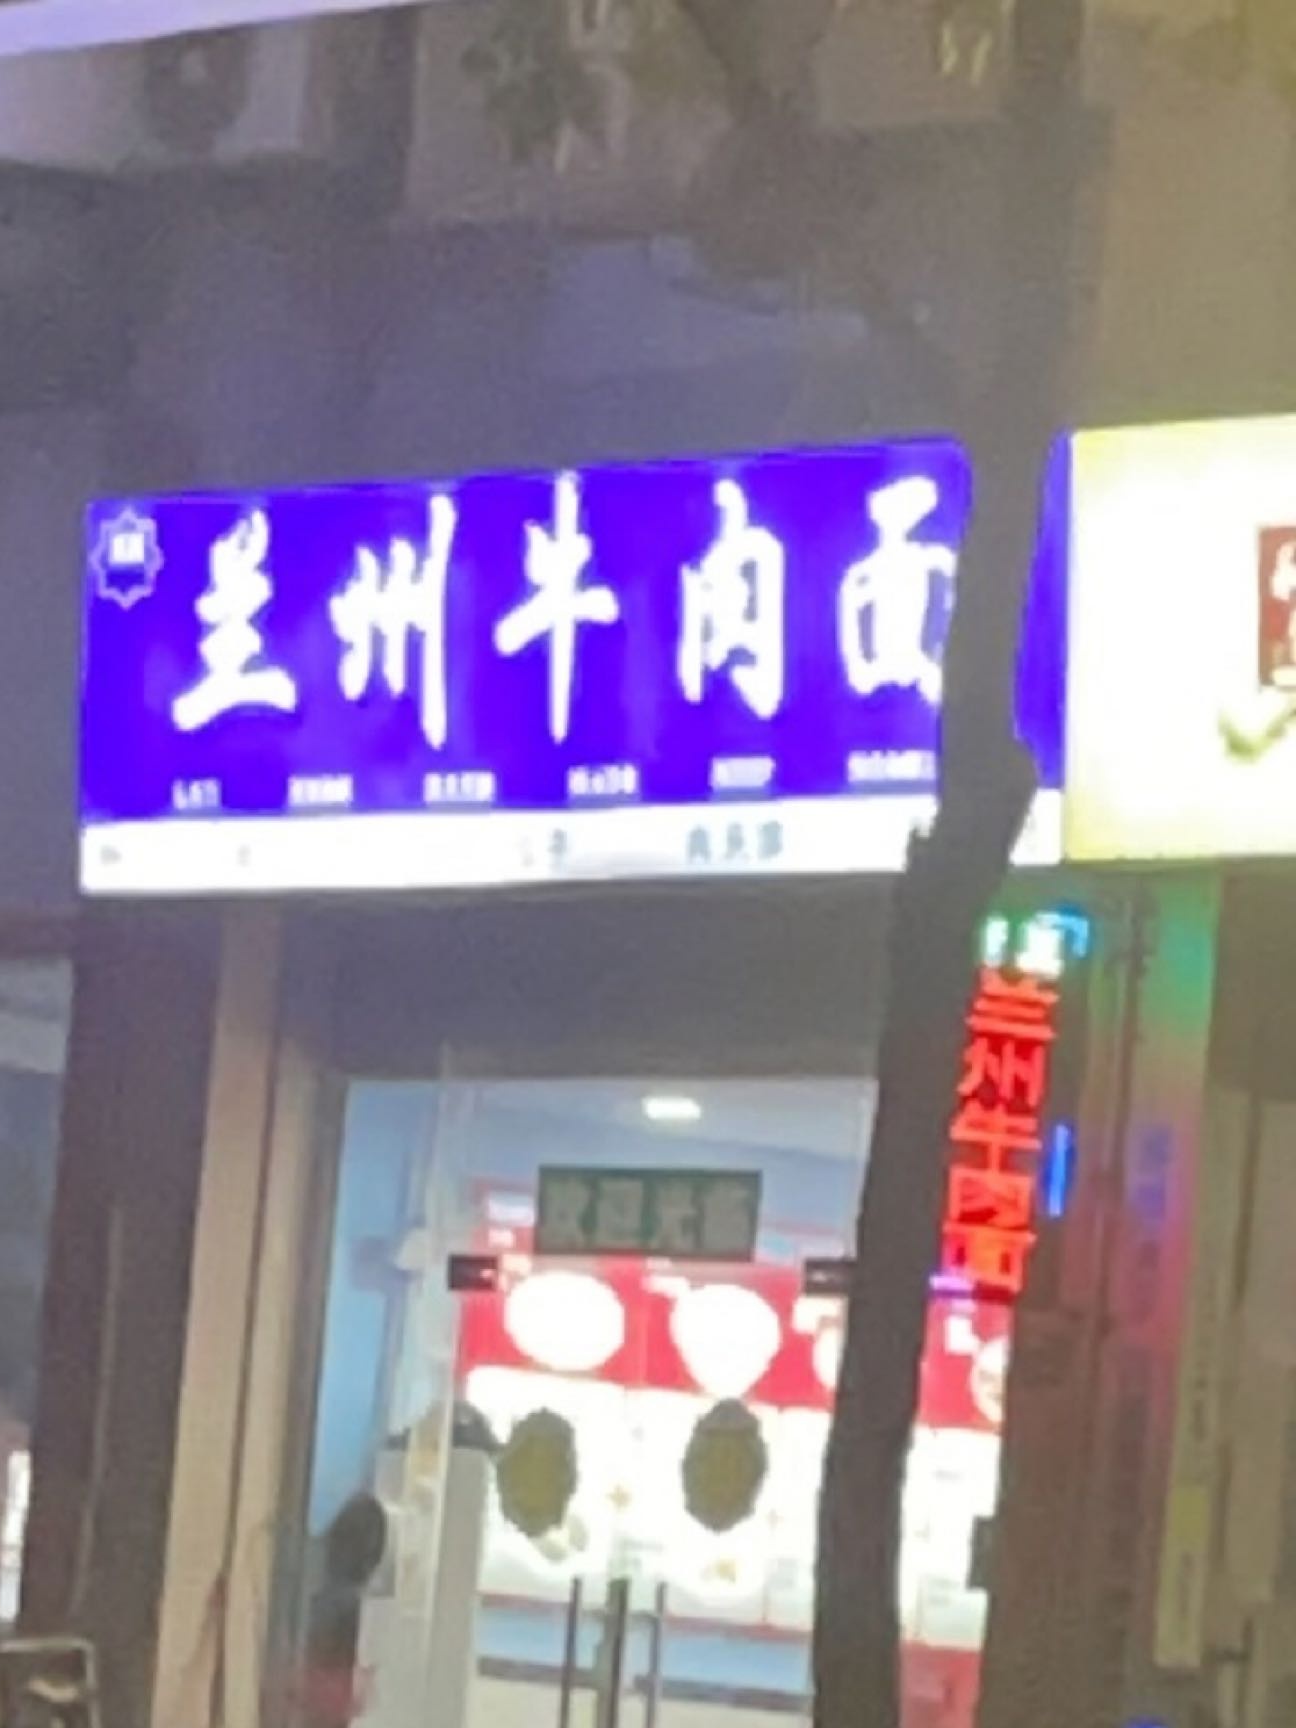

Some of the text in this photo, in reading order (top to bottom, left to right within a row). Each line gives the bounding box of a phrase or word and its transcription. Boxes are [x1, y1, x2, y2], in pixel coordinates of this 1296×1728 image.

[170, 469, 957, 750] 兰州牛肉面
